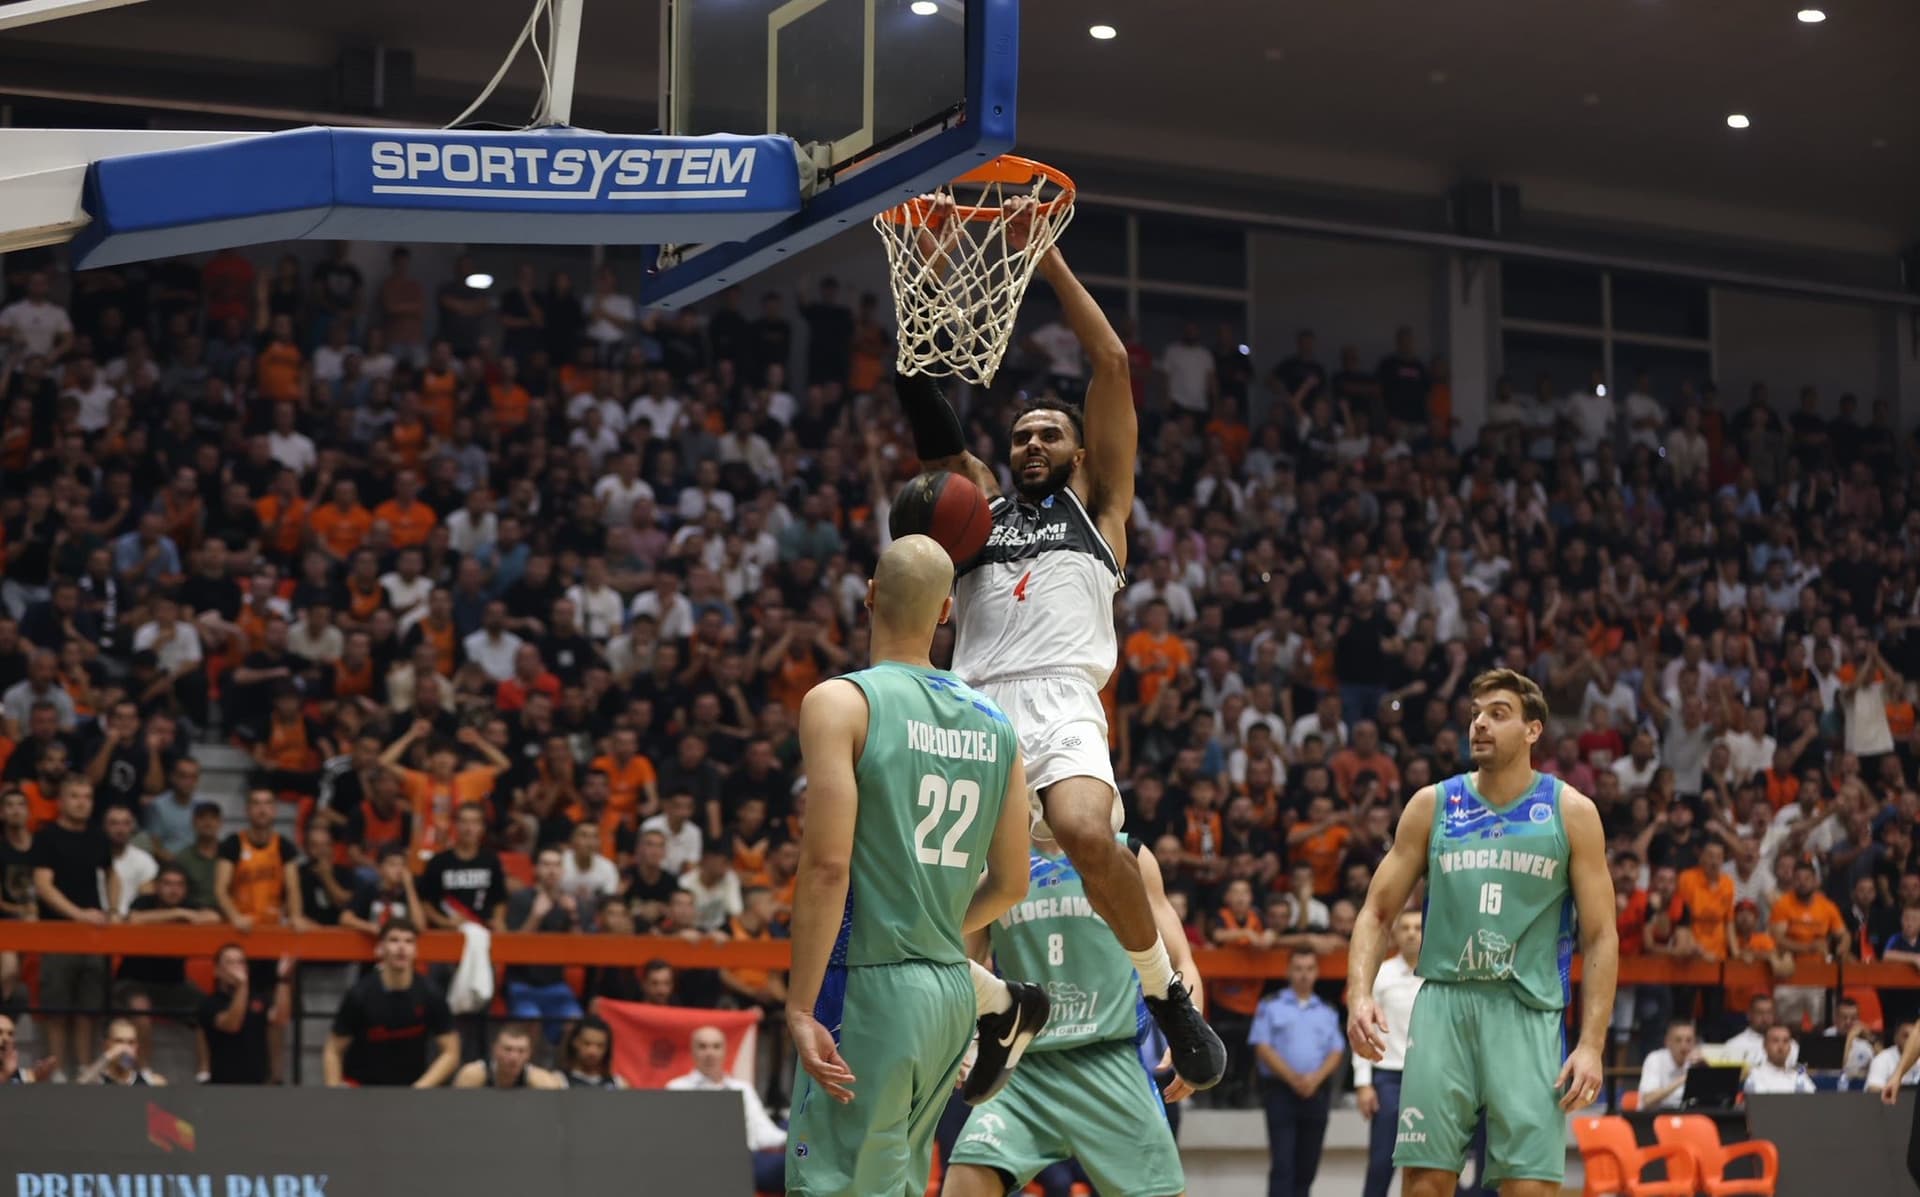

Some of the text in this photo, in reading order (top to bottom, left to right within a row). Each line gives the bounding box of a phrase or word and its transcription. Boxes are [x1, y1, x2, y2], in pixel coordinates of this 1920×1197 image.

[371, 141, 757, 199] SPORTSYSTEM
[907, 720, 997, 763] KOŁODZIEJ
[914, 774, 980, 869] 22
[1438, 849, 1559, 880] WŁOCŁAWEK
[1479, 882, 1503, 916] 15
[1047, 933, 1064, 966] 8
